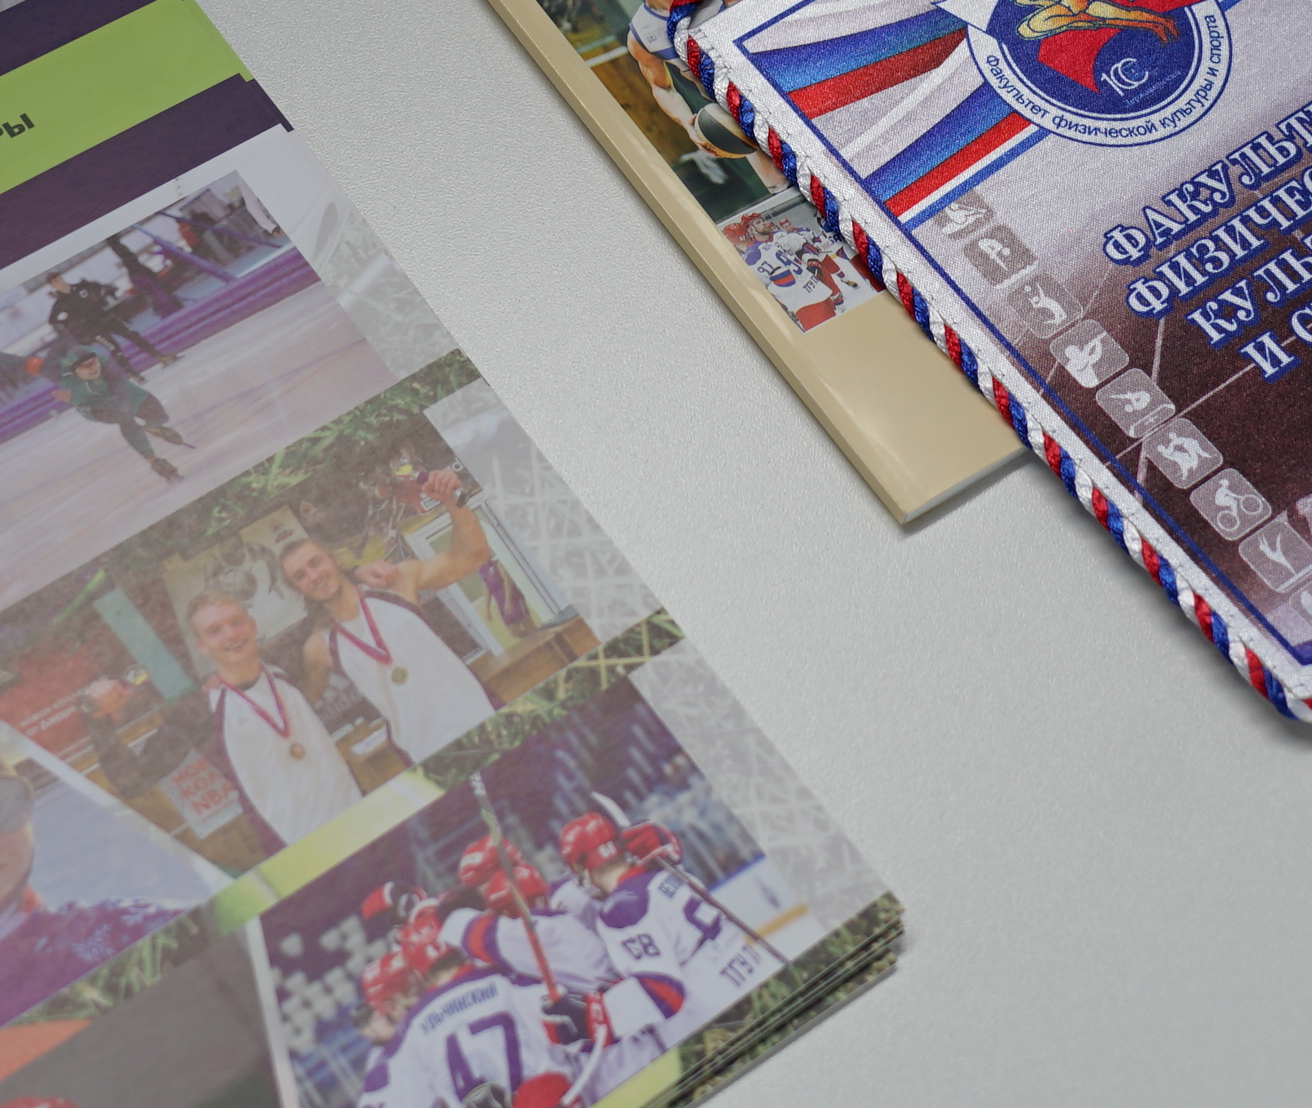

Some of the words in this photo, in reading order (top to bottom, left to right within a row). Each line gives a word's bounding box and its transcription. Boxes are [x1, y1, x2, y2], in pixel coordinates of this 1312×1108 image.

[1204, 13, 1225, 65] спорта
[985, 53, 1051, 121] Факультет
[1208, 64, 1221, 78] и
[1050, 114, 1160, 141] физической
[1158, 79, 1217, 130] культуры
[1238, 329, 1301, 385] И
[445, 1009, 524, 1104] 47
